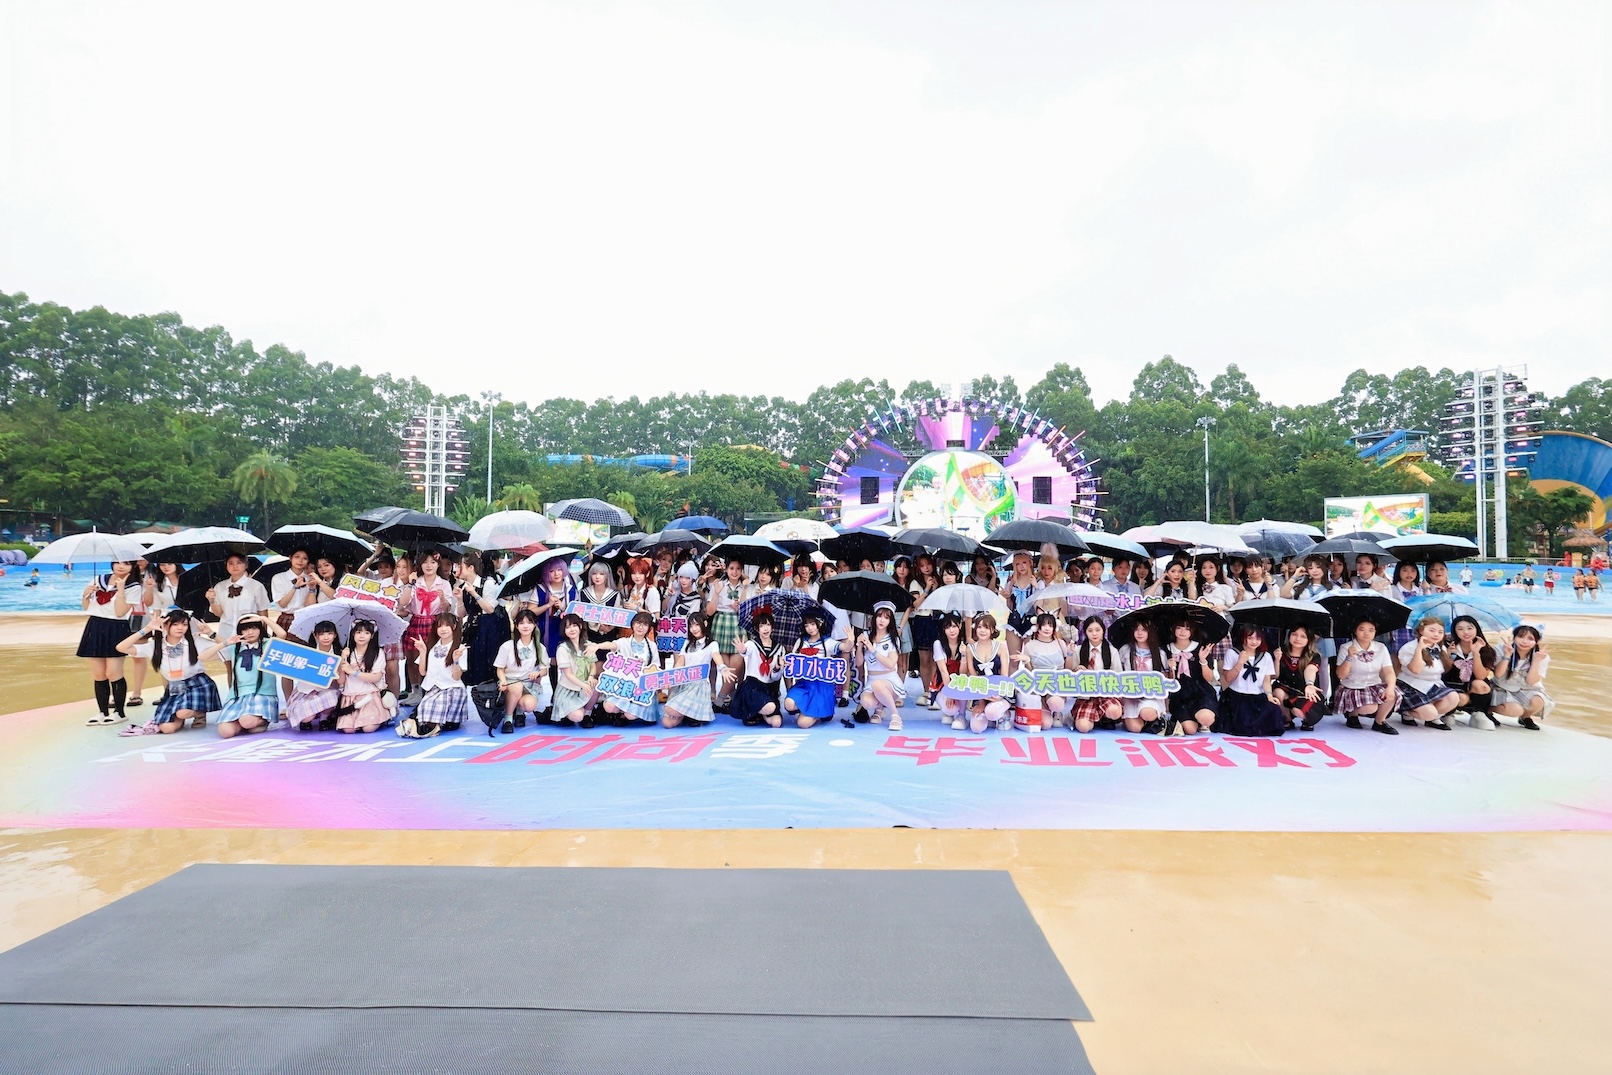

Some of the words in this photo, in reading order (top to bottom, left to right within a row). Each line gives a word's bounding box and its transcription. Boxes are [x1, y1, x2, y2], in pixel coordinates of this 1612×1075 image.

[573, 603, 629, 625] 勇士认证
[657, 617, 687, 634] 冲天
[267, 648, 334, 678] 毕业第一站
[604, 653, 644, 678] 冲天
[786, 655, 845, 682] 打水战
[644, 666, 703, 690] 勇士认证
[1014, 671, 1176, 695] 今天也很快乐鸭~
